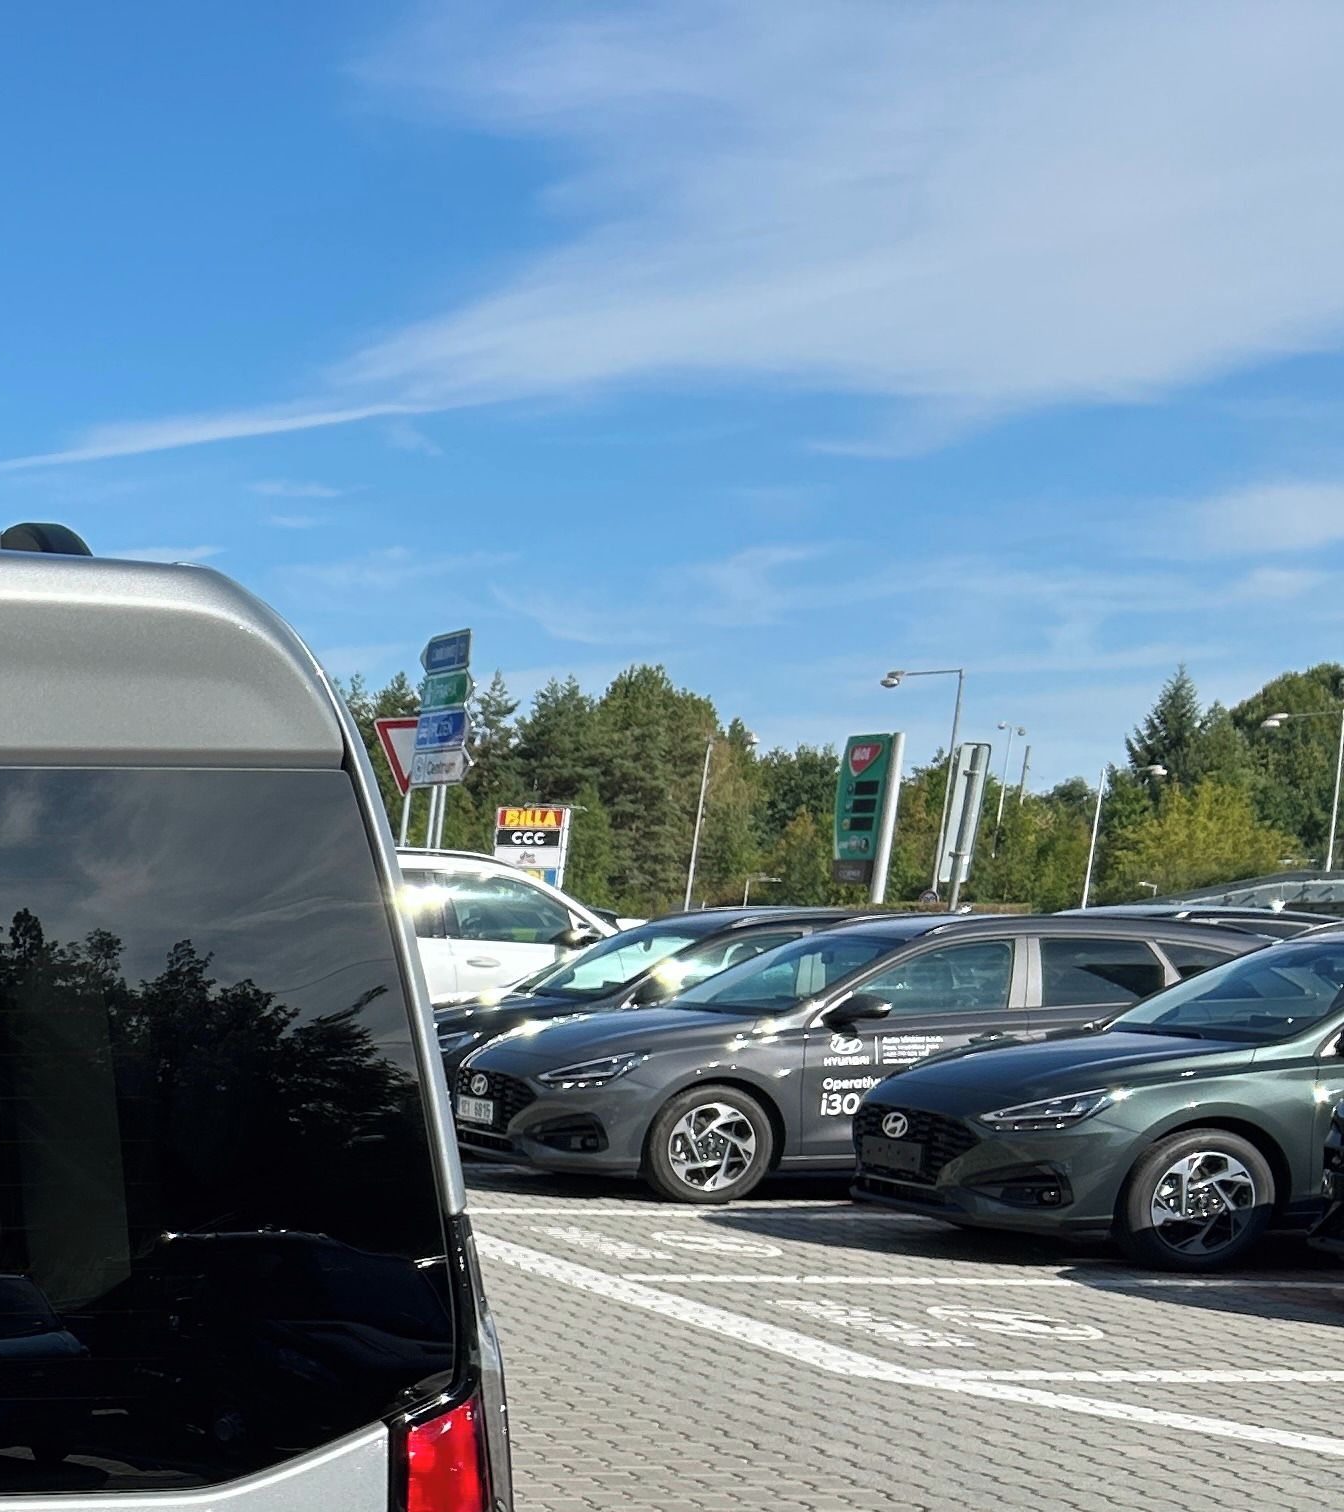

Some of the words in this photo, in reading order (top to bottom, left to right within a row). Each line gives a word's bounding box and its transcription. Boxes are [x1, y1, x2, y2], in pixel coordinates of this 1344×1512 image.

[505, 809, 557, 827] BILLA
[511, 831, 546, 845] CCC
[823, 1056, 870, 1066] HYUNDAI
[820, 1092, 860, 1116] i30
